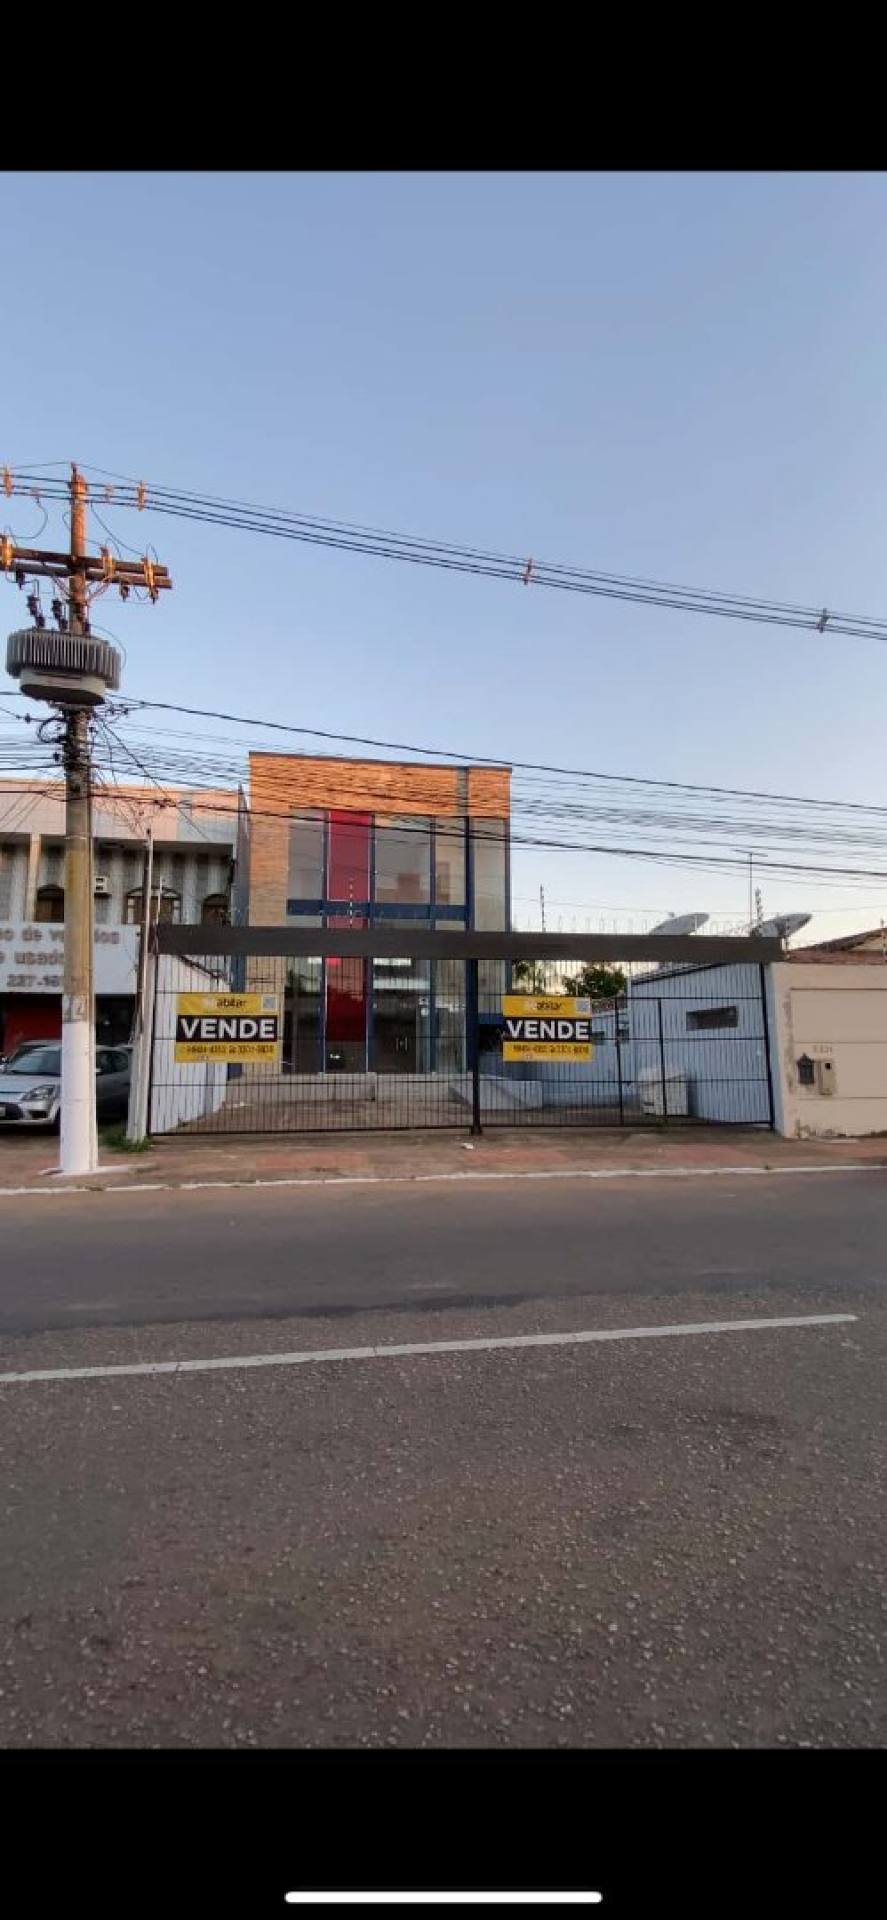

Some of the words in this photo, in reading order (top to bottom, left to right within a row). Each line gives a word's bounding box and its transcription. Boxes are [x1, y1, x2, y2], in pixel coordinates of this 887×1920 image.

[22, 925, 42, 941] de
[180, 1018, 275, 1039] VENDE
[506, 1020, 590, 1040] VENDE
